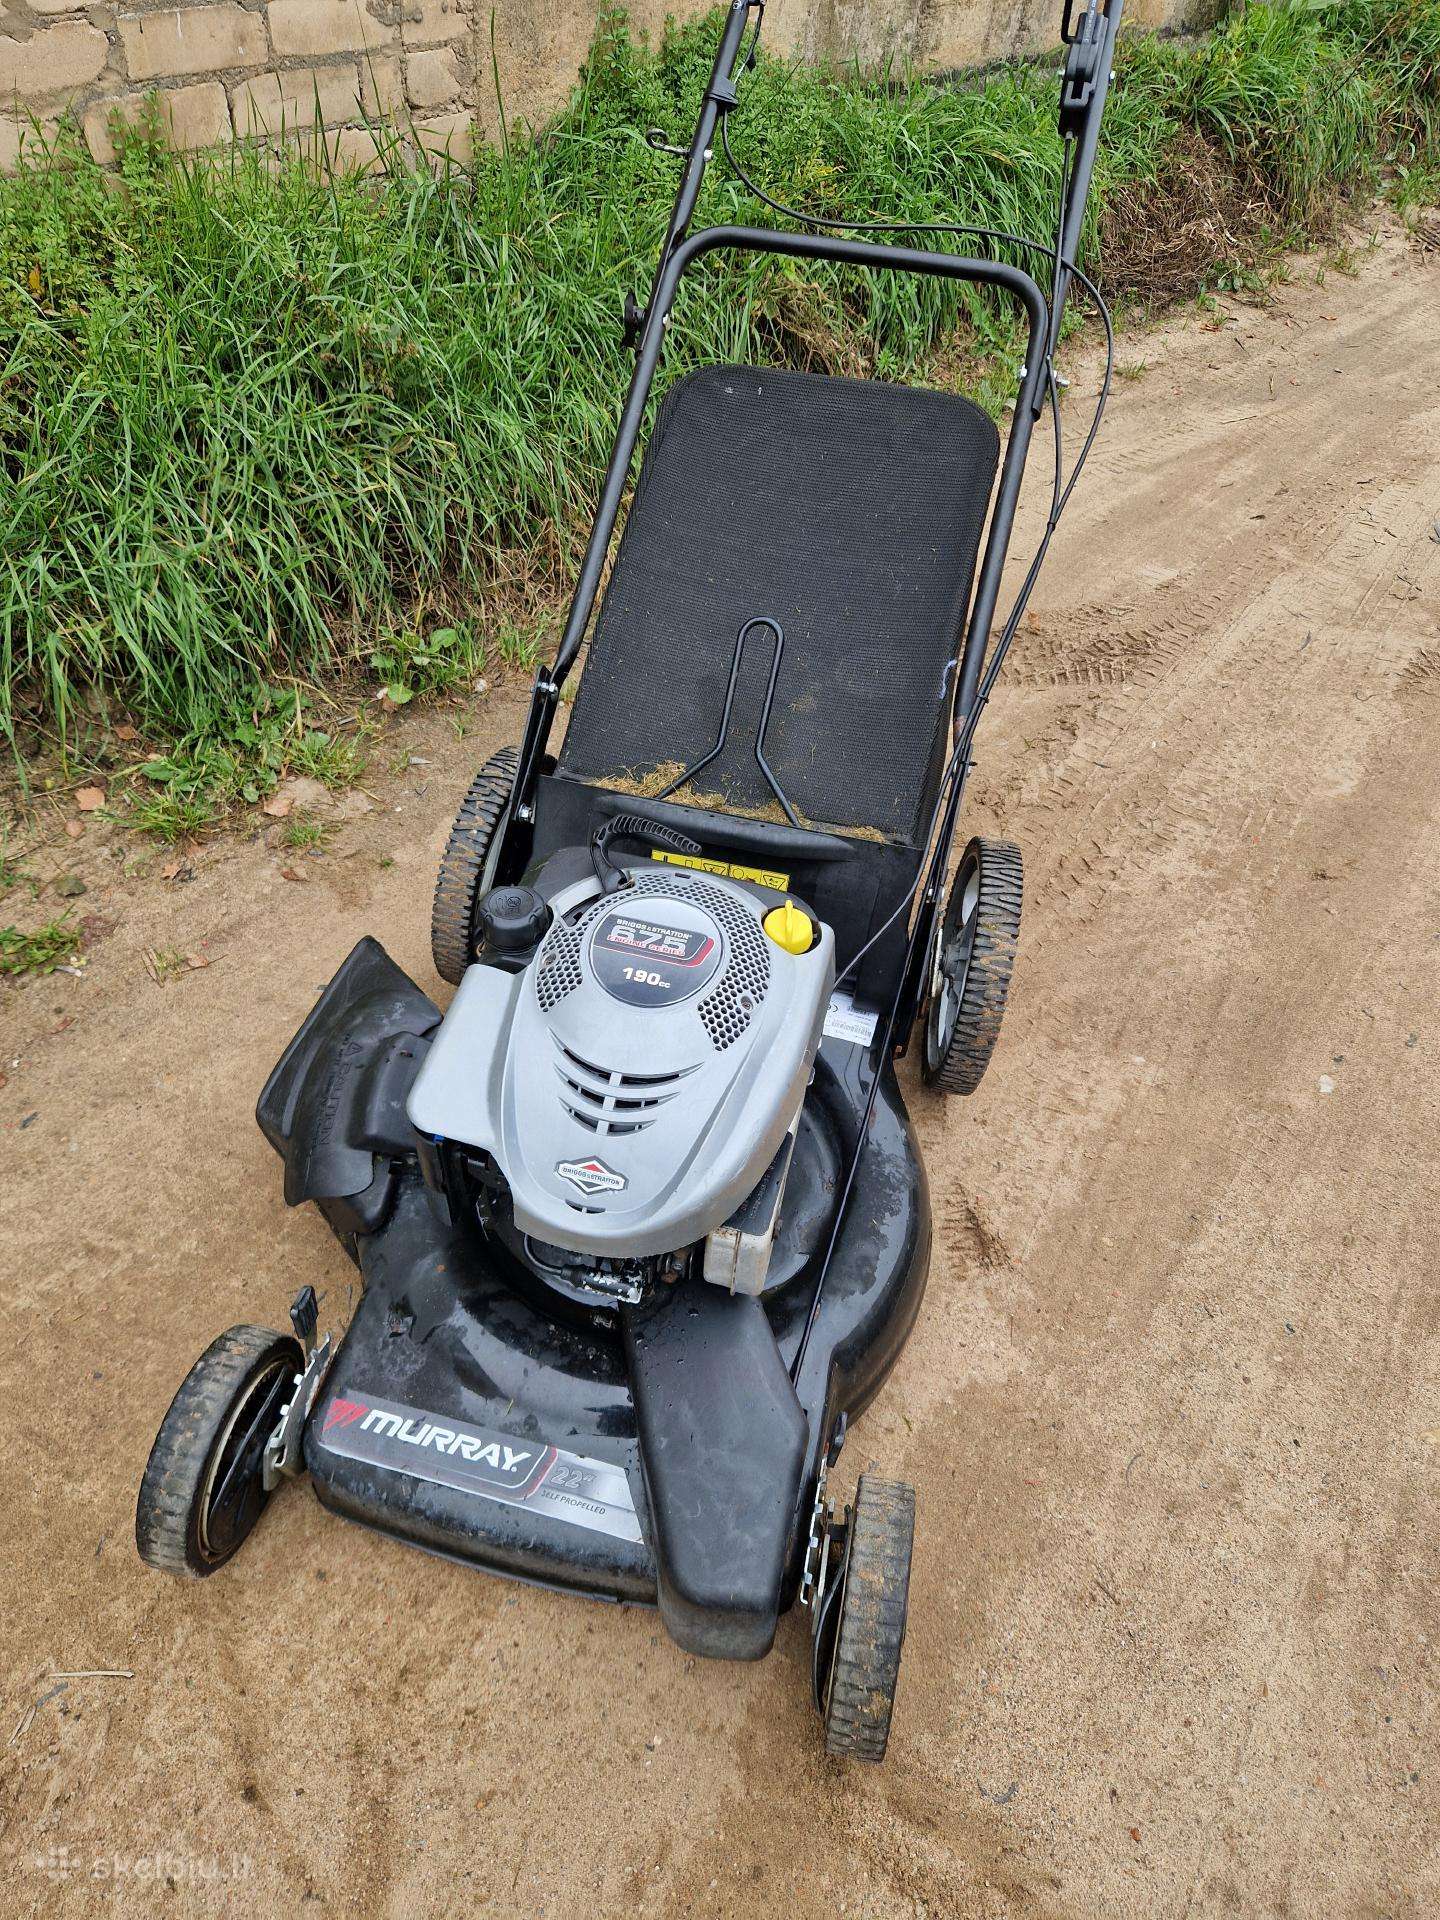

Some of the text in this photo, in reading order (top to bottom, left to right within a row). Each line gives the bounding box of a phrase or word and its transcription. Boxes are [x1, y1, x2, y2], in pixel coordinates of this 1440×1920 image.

[611, 925, 687, 953] 675
[541, 1488, 607, 1516] SELF PROPELLED
